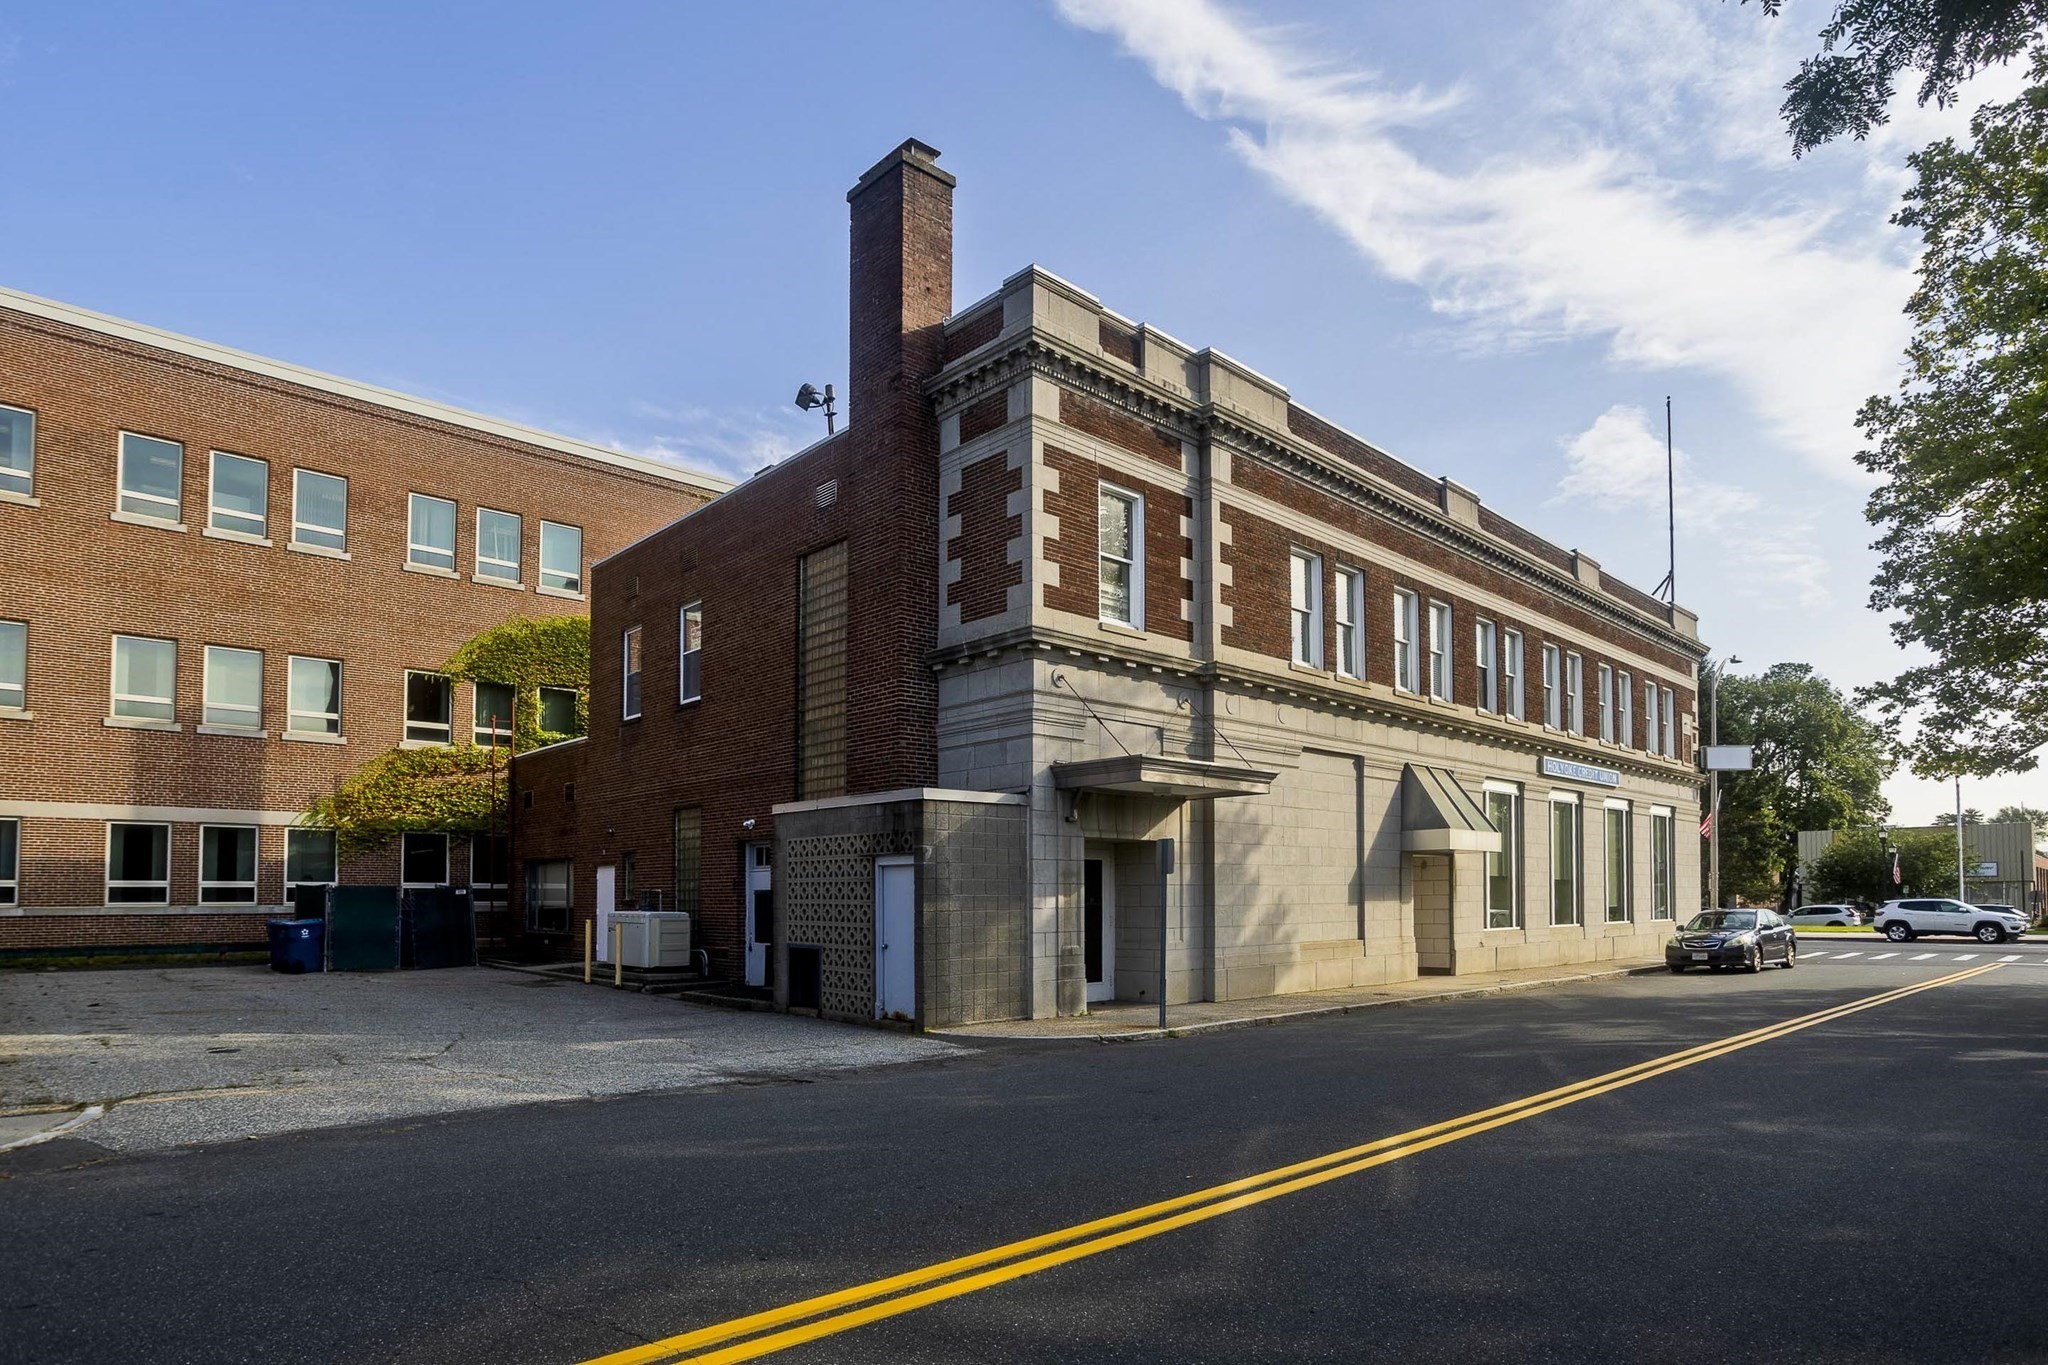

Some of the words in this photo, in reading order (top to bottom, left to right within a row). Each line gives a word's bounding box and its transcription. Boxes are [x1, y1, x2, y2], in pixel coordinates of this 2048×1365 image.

[1547, 760, 1576, 776] HOLYOKE
[1578, 766, 1598, 780] CREDIT
[1599, 771, 1617, 783] UNION
